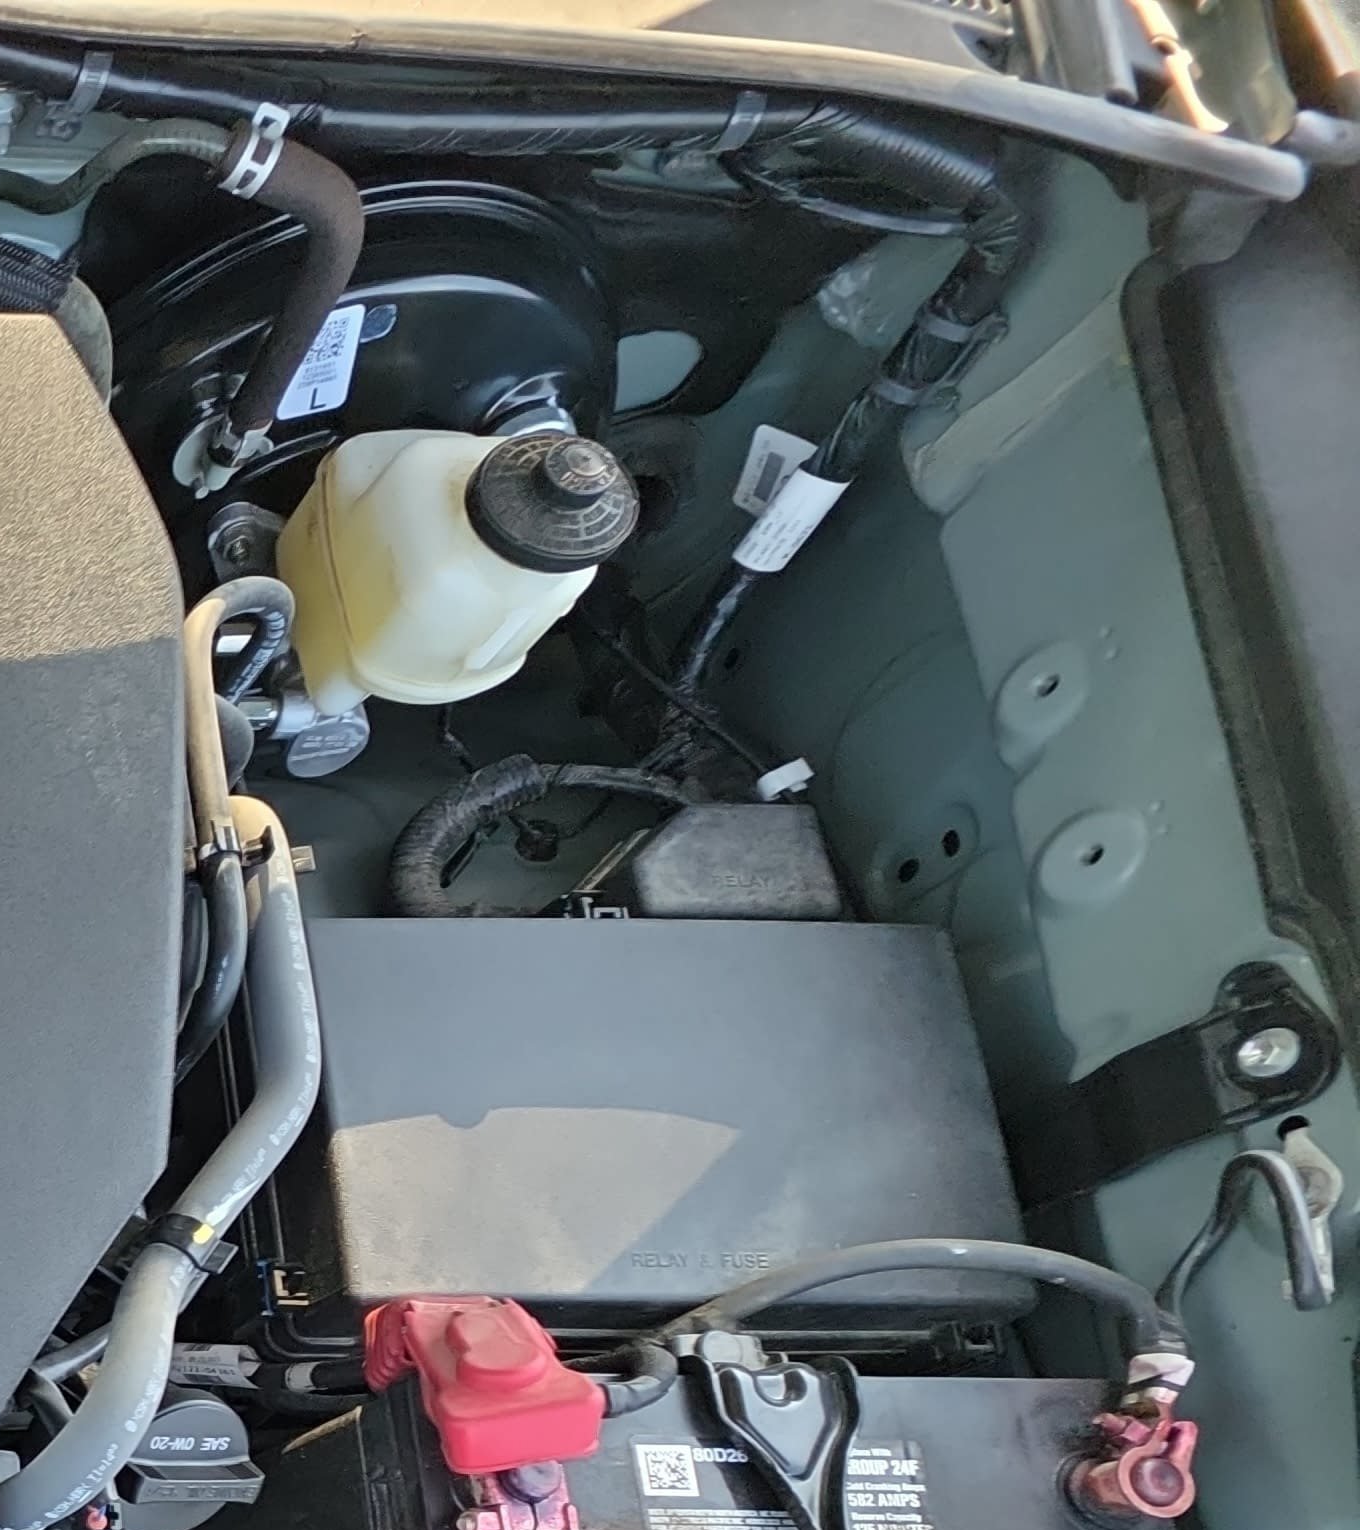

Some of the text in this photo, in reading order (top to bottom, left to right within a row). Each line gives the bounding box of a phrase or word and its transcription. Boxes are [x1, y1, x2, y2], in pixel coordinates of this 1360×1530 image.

[631, 1249, 689, 1269] RELAY
[719, 1250, 770, 1269] FUSE
[150, 1436, 232, 1451] SAE 0W-20
[890, 1459, 920, 1476] 24F
[847, 1493, 921, 1508] 582 AMPS
